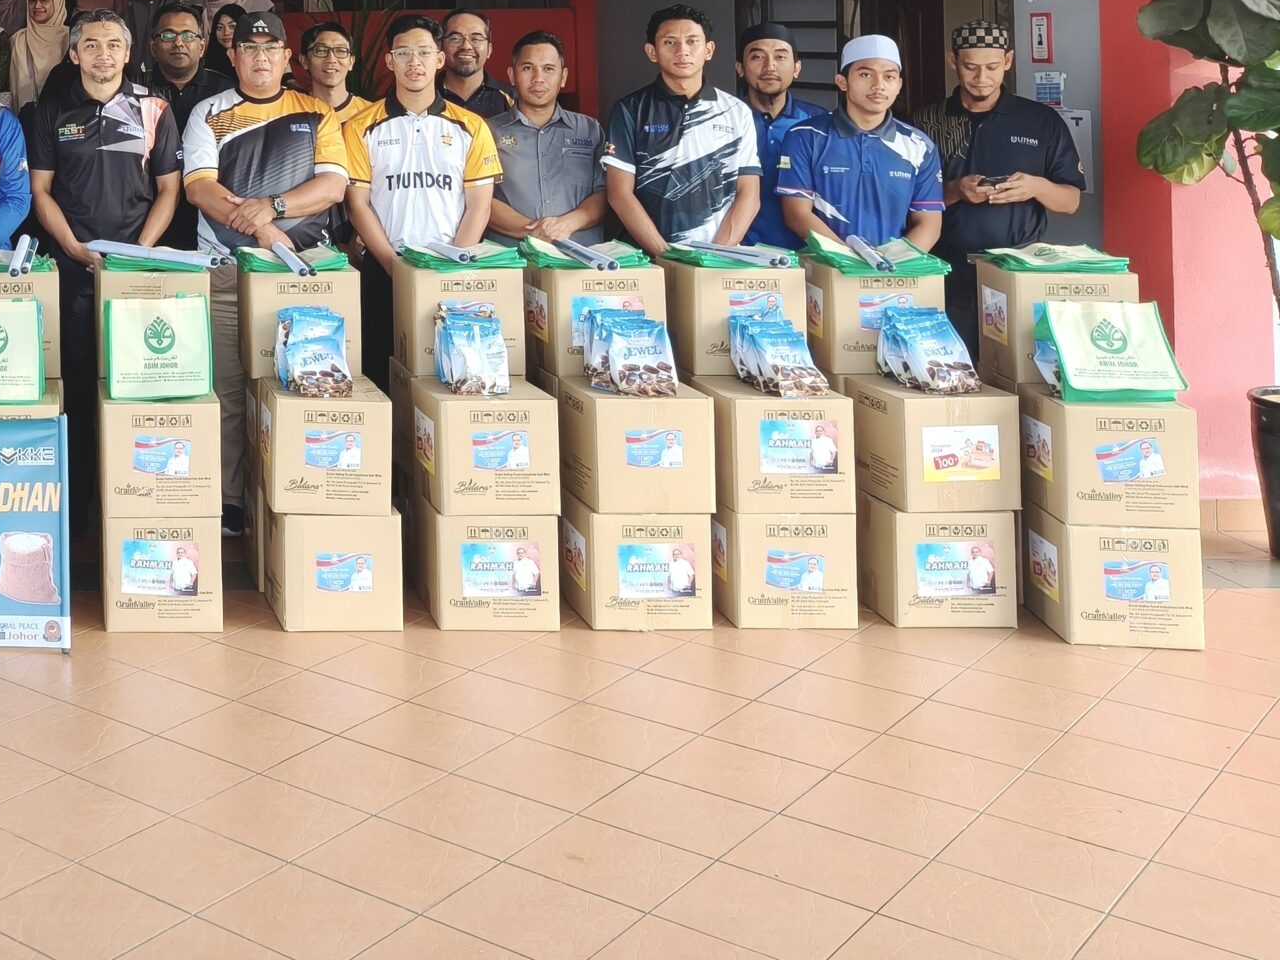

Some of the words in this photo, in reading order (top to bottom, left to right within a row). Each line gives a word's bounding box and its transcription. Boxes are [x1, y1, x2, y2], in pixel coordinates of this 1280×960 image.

[59, 126, 85, 135] FEST
[623, 345, 662, 360] JEWEL
[768, 439, 812, 449] RAHMAH
[17, 448, 55, 458] KKE
[284, 476, 321, 492] Bidara
[453, 479, 490, 494] Bidara
[747, 477, 784, 493] Bidara
[1077, 490, 1123, 502] GrainValley
[129, 559, 173, 570] RAHMAH
[470, 561, 514, 572] RAHMAH
[626, 563, 669, 572] RAHMAH
[925, 561, 968, 571] RAHMAH
[115, 600, 156, 610] GrainValley
[449, 598, 491, 609] GrainValley
[748, 597, 789, 607] GrainValley
[1081, 610, 1127, 623] GrainValley
[18, 622, 39, 630] PEACE
[6, 631, 39, 640] Johor
